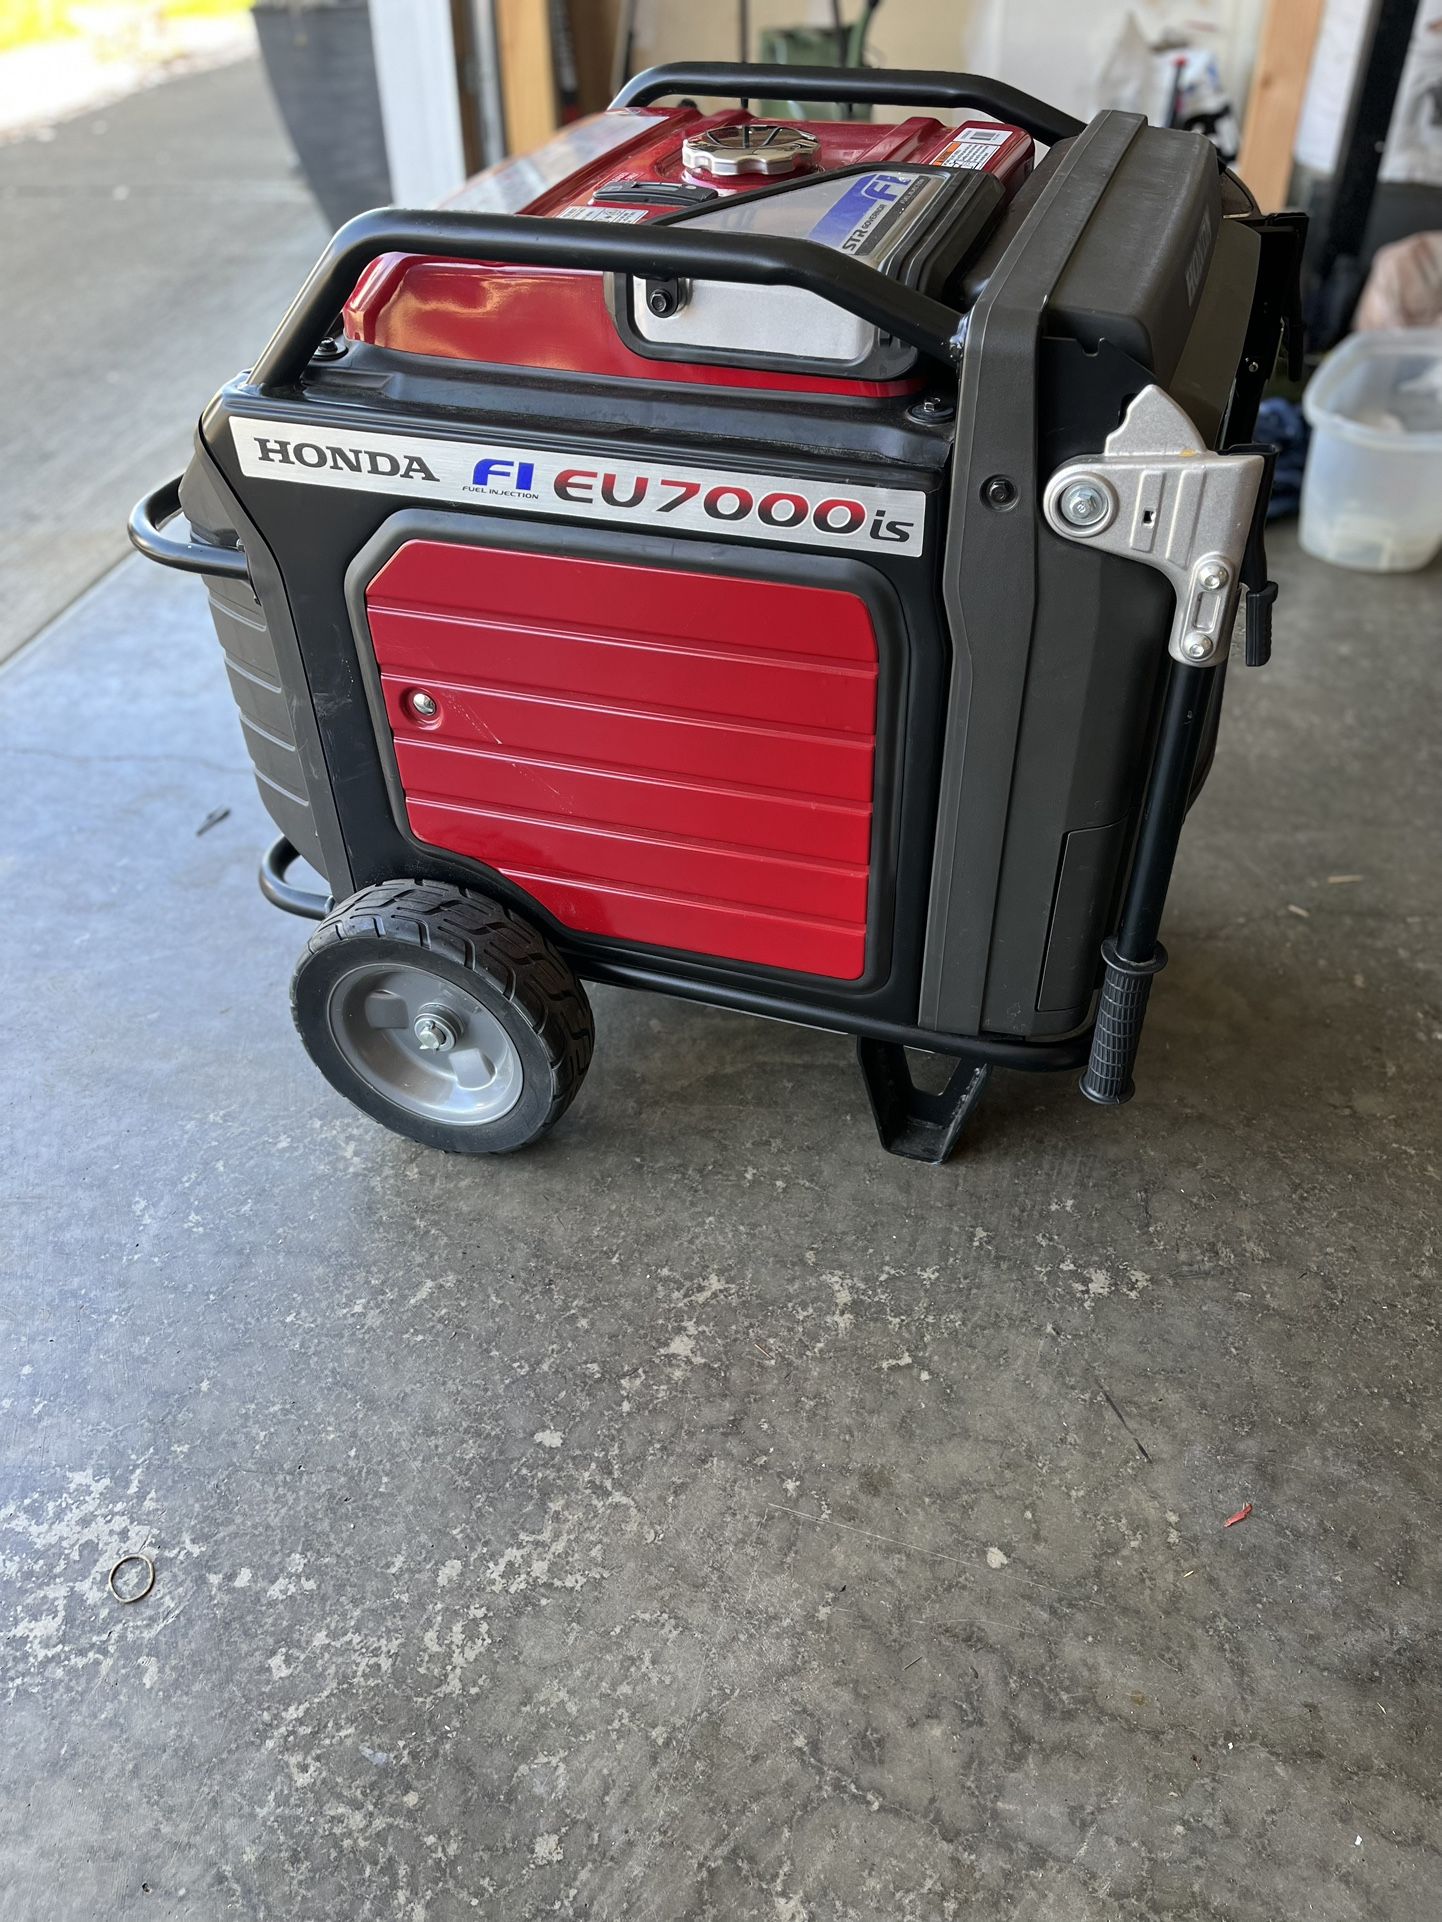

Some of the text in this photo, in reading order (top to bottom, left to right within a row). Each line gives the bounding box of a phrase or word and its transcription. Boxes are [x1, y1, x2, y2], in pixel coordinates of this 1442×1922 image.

[842, 203, 888, 252] STR GOVERNOR
[253, 437, 914, 543] HONDA FI EU7000is
[462, 485, 539, 500] FUEL INJECTION
